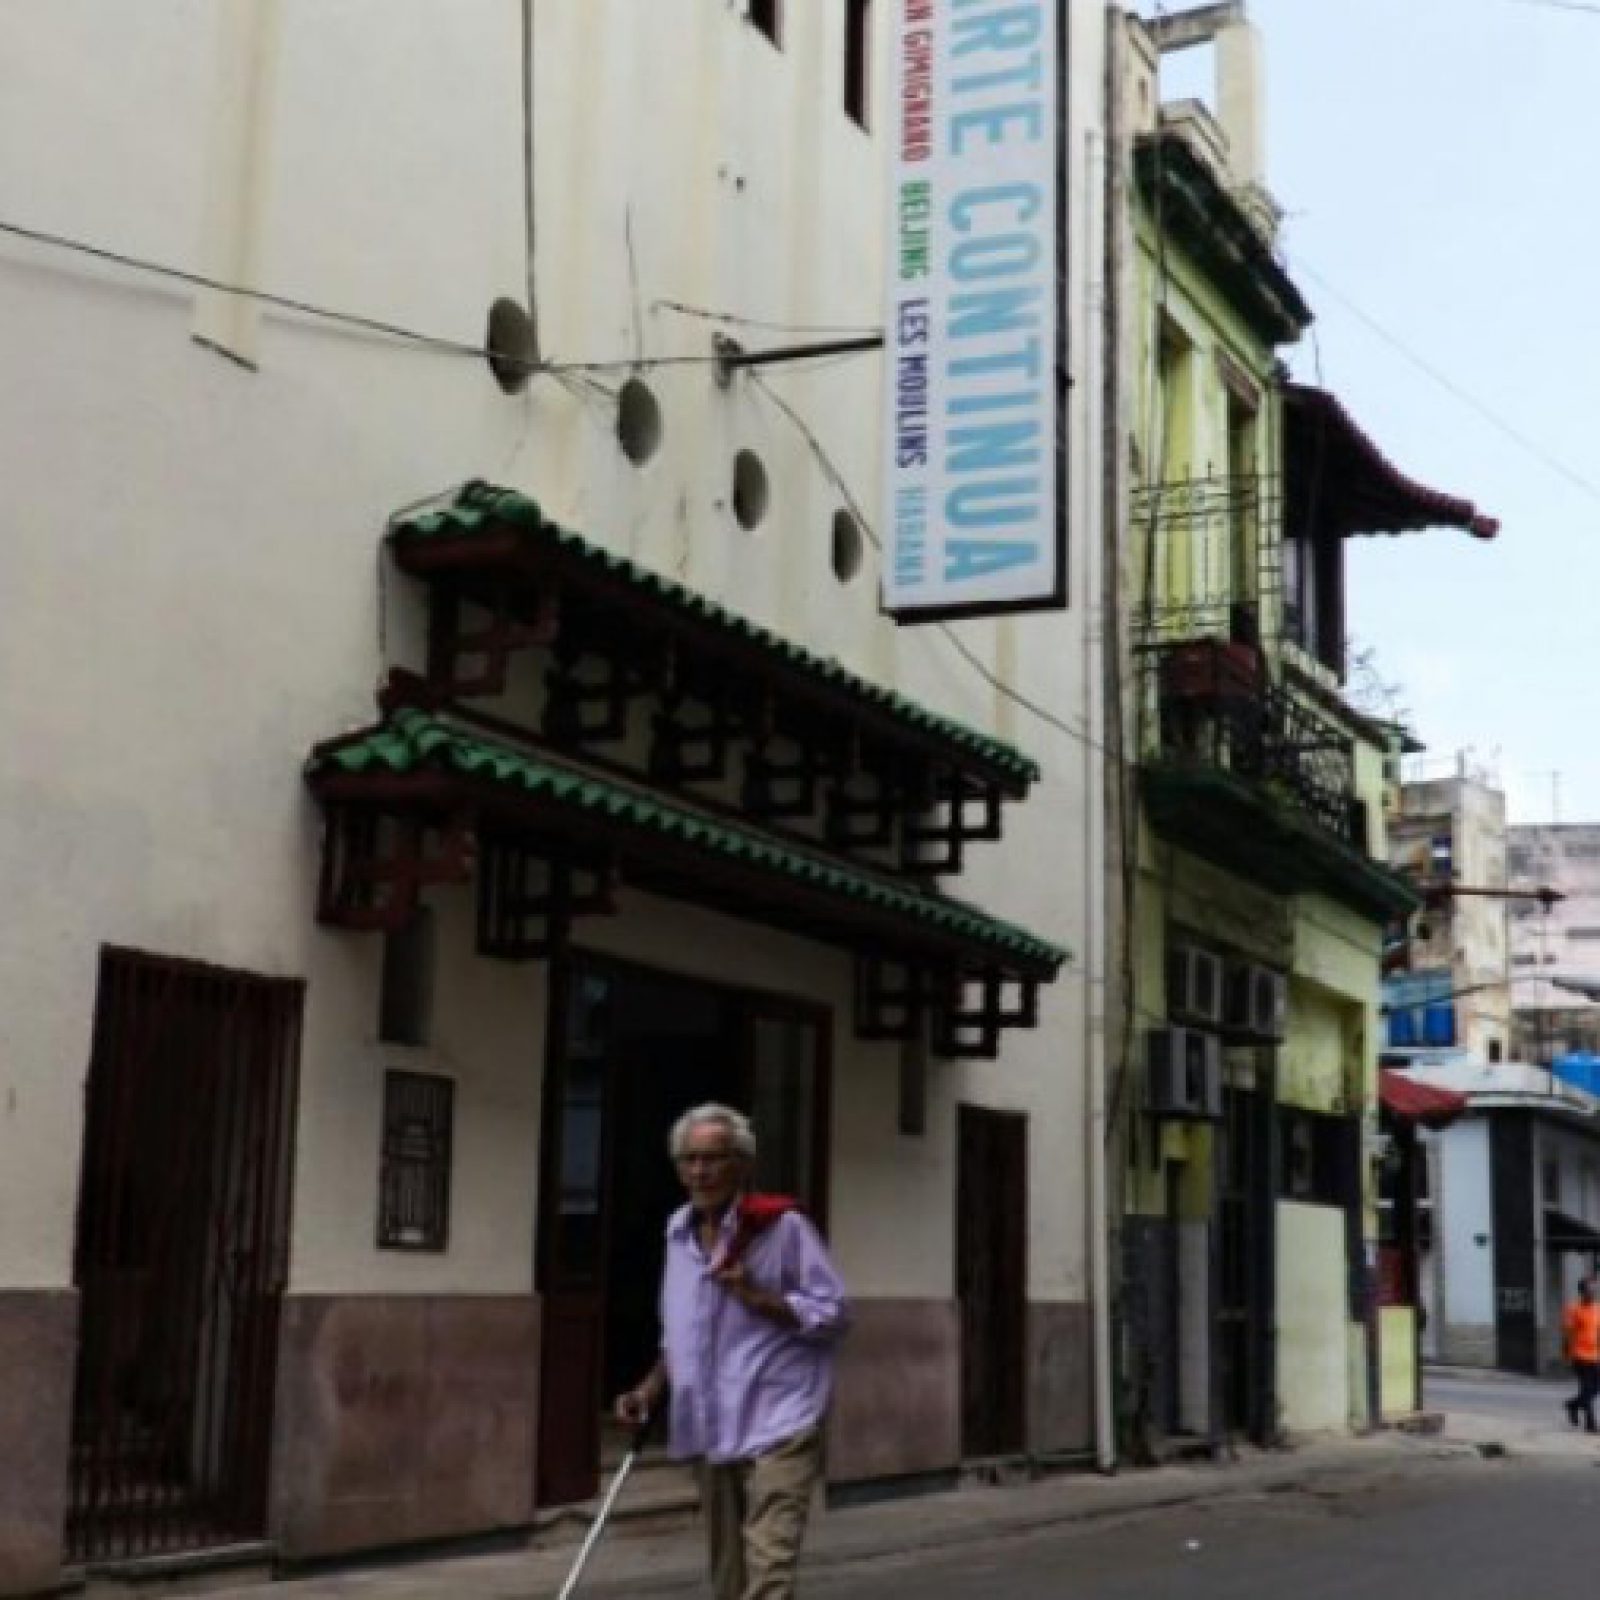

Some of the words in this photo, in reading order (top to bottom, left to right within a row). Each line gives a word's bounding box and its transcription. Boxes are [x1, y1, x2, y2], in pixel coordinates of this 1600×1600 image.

[902, 31, 931, 161] GIMIGNANO
[950, 0, 1041, 155] RTE
[899, 180, 930, 279] BEIJING
[898, 297, 929, 348] LES
[945, 181, 1041, 582] CONTINUA
[896, 354, 928, 468] MOULINS
